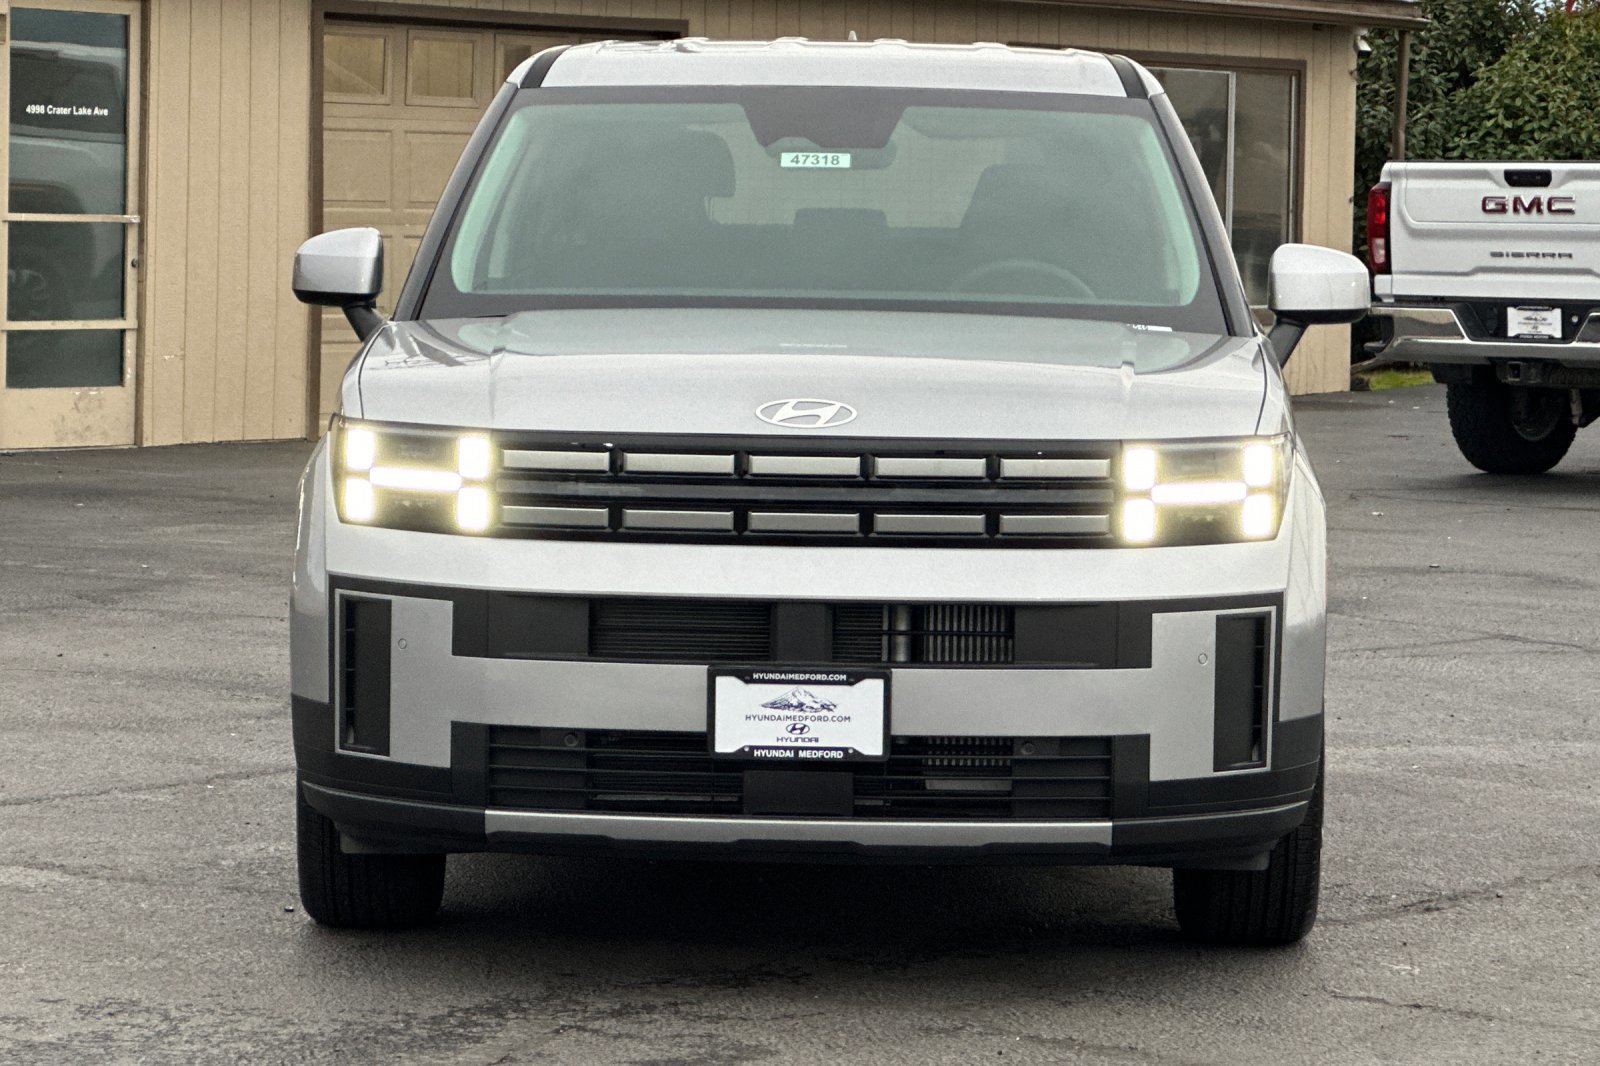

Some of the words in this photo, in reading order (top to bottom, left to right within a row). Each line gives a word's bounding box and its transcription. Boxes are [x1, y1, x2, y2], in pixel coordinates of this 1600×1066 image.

[25, 104, 46, 114] 4998
[46, 104, 72, 115] Crater
[72, 105, 92, 116] Lake
[93, 106, 109, 116] Ave
[790, 153, 840, 166] 47318
[1481, 195, 1576, 215] GMC
[1490, 251, 1573, 259] SIERRA
[752, 672, 847, 682] HYUNDAIMEDFORD.COM
[745, 714, 851, 723] HYUNDAIMEDFORD.COM
[753, 749, 794, 758] HYUNDAI
[798, 750, 844, 759] MEDFORD
